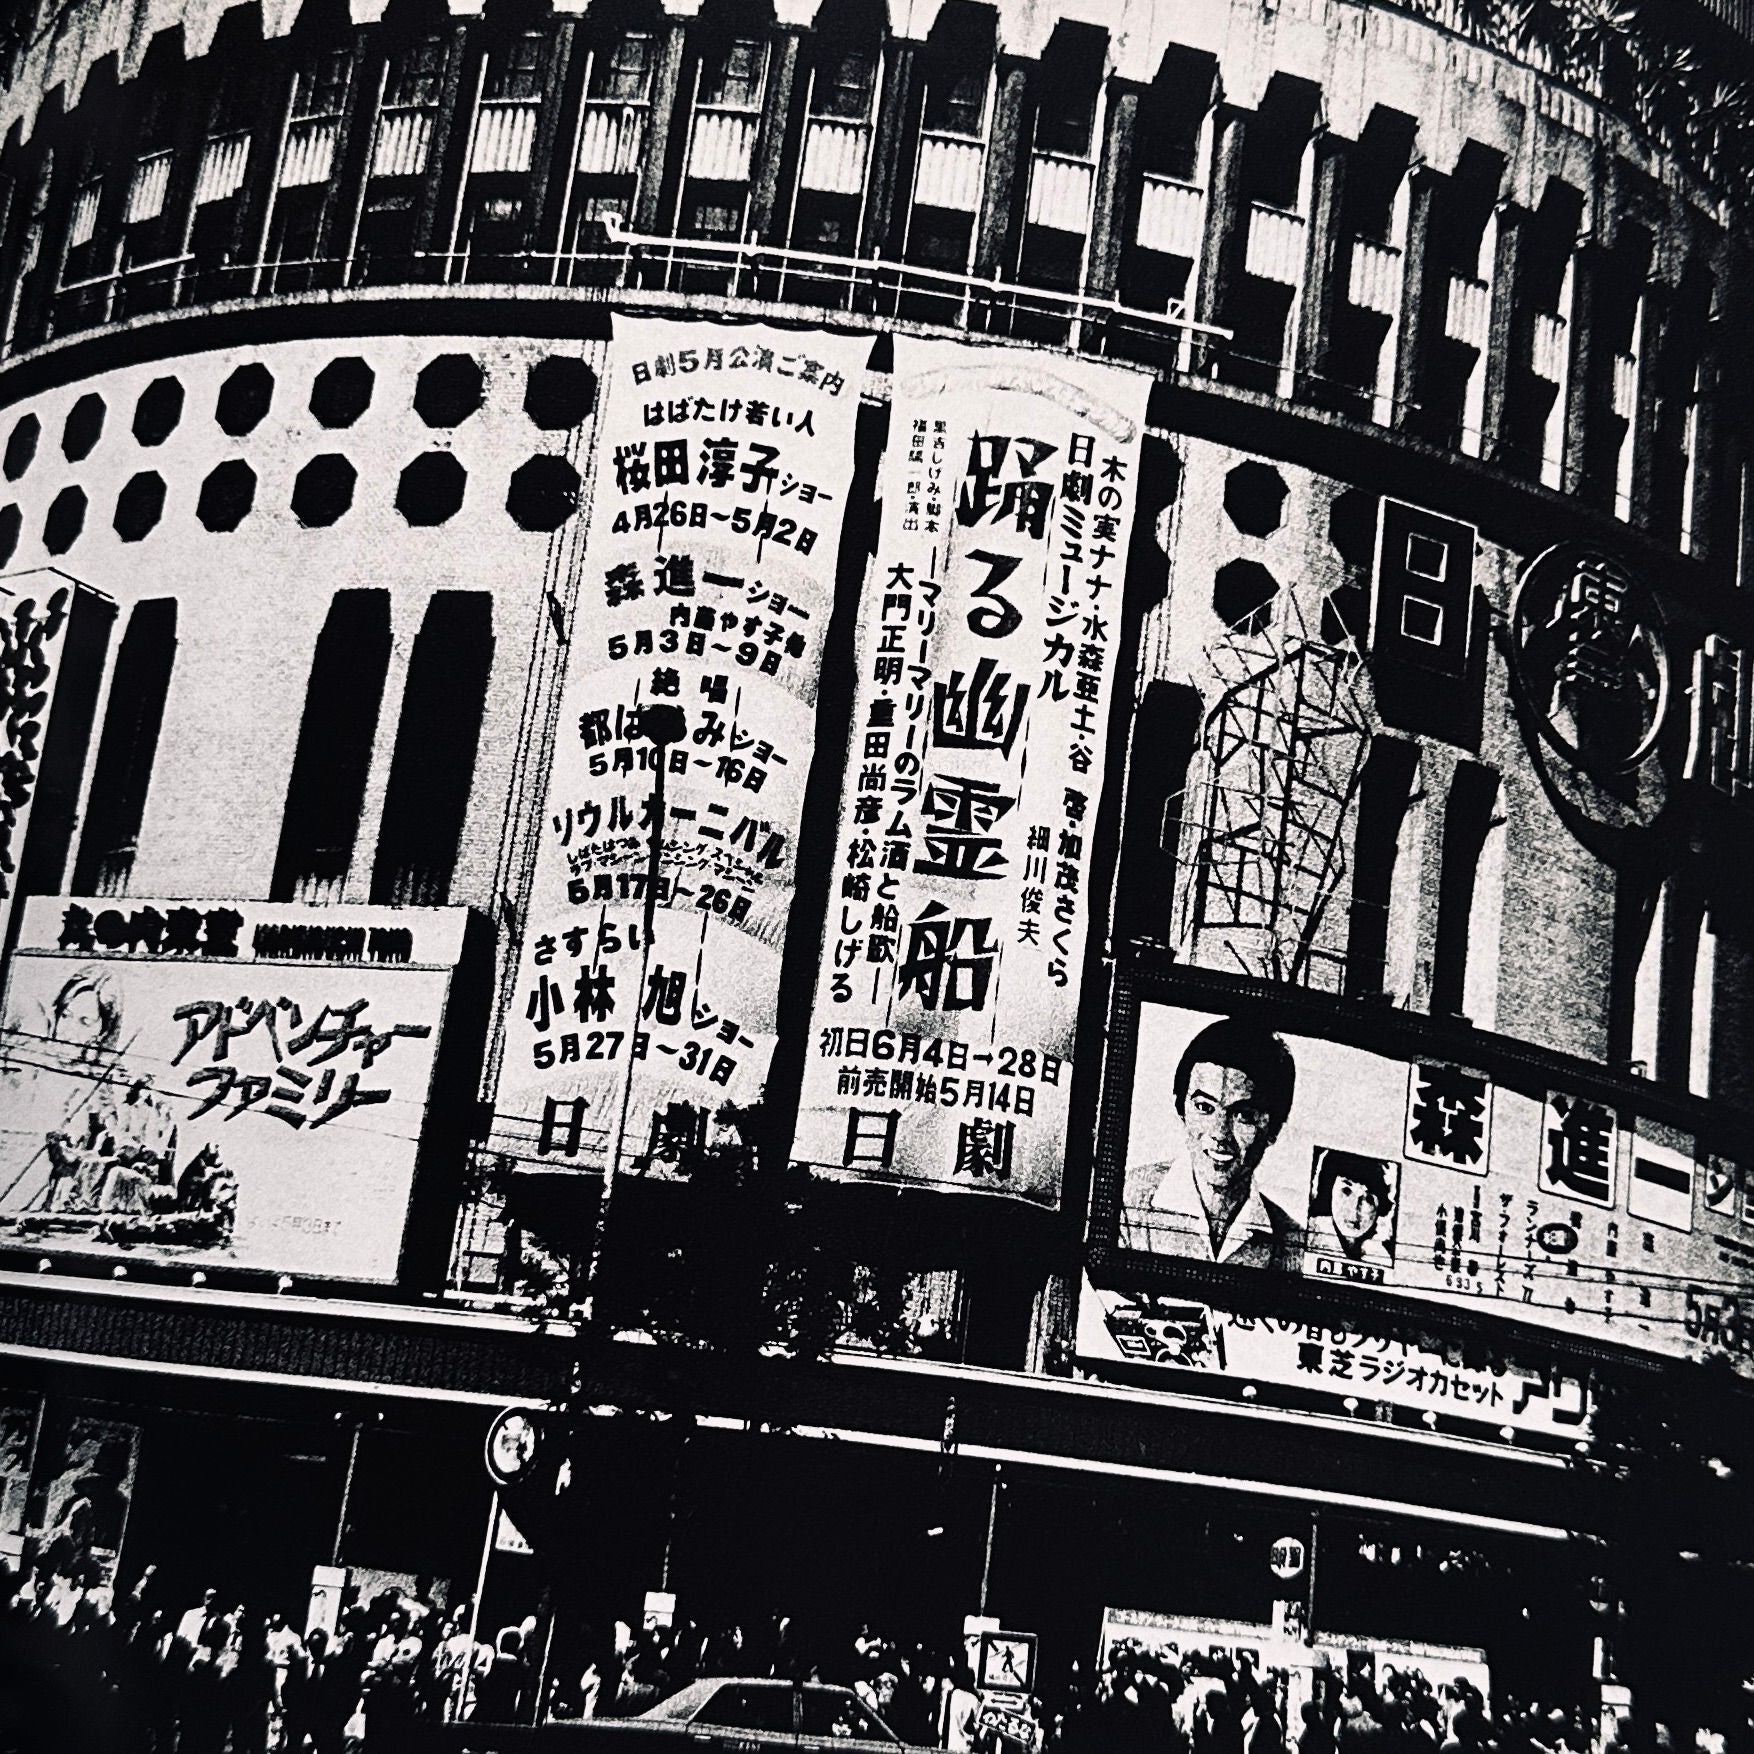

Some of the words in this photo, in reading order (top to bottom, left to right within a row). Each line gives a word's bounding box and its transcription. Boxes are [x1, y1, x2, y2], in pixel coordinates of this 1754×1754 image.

[643, 396, 815, 437] はばたけ若い人
[612, 437, 833, 504] 桜田淳子ショー
[604, 553, 811, 620] 森進一ショー
[1037, 432, 1096, 702] 日劇ミュージカル
[578, 703, 788, 767] 都はみショー
[898, 428, 1059, 1012] 踊る幽霊船
[1016, 825, 1051, 946] 細川俊夫
[534, 922, 655, 966] さすらい
[171, 996, 432, 1067] アドベンチャー
[525, 963, 755, 1049] 小林旭ショー
[186, 1066, 392, 1130] ファミリー
[836, 1065, 1035, 1118] 前売開始5月14日
[842, 1107, 1016, 1181] 日劇
[1297, 1341, 1504, 1407] 東芝ラジオカセット
